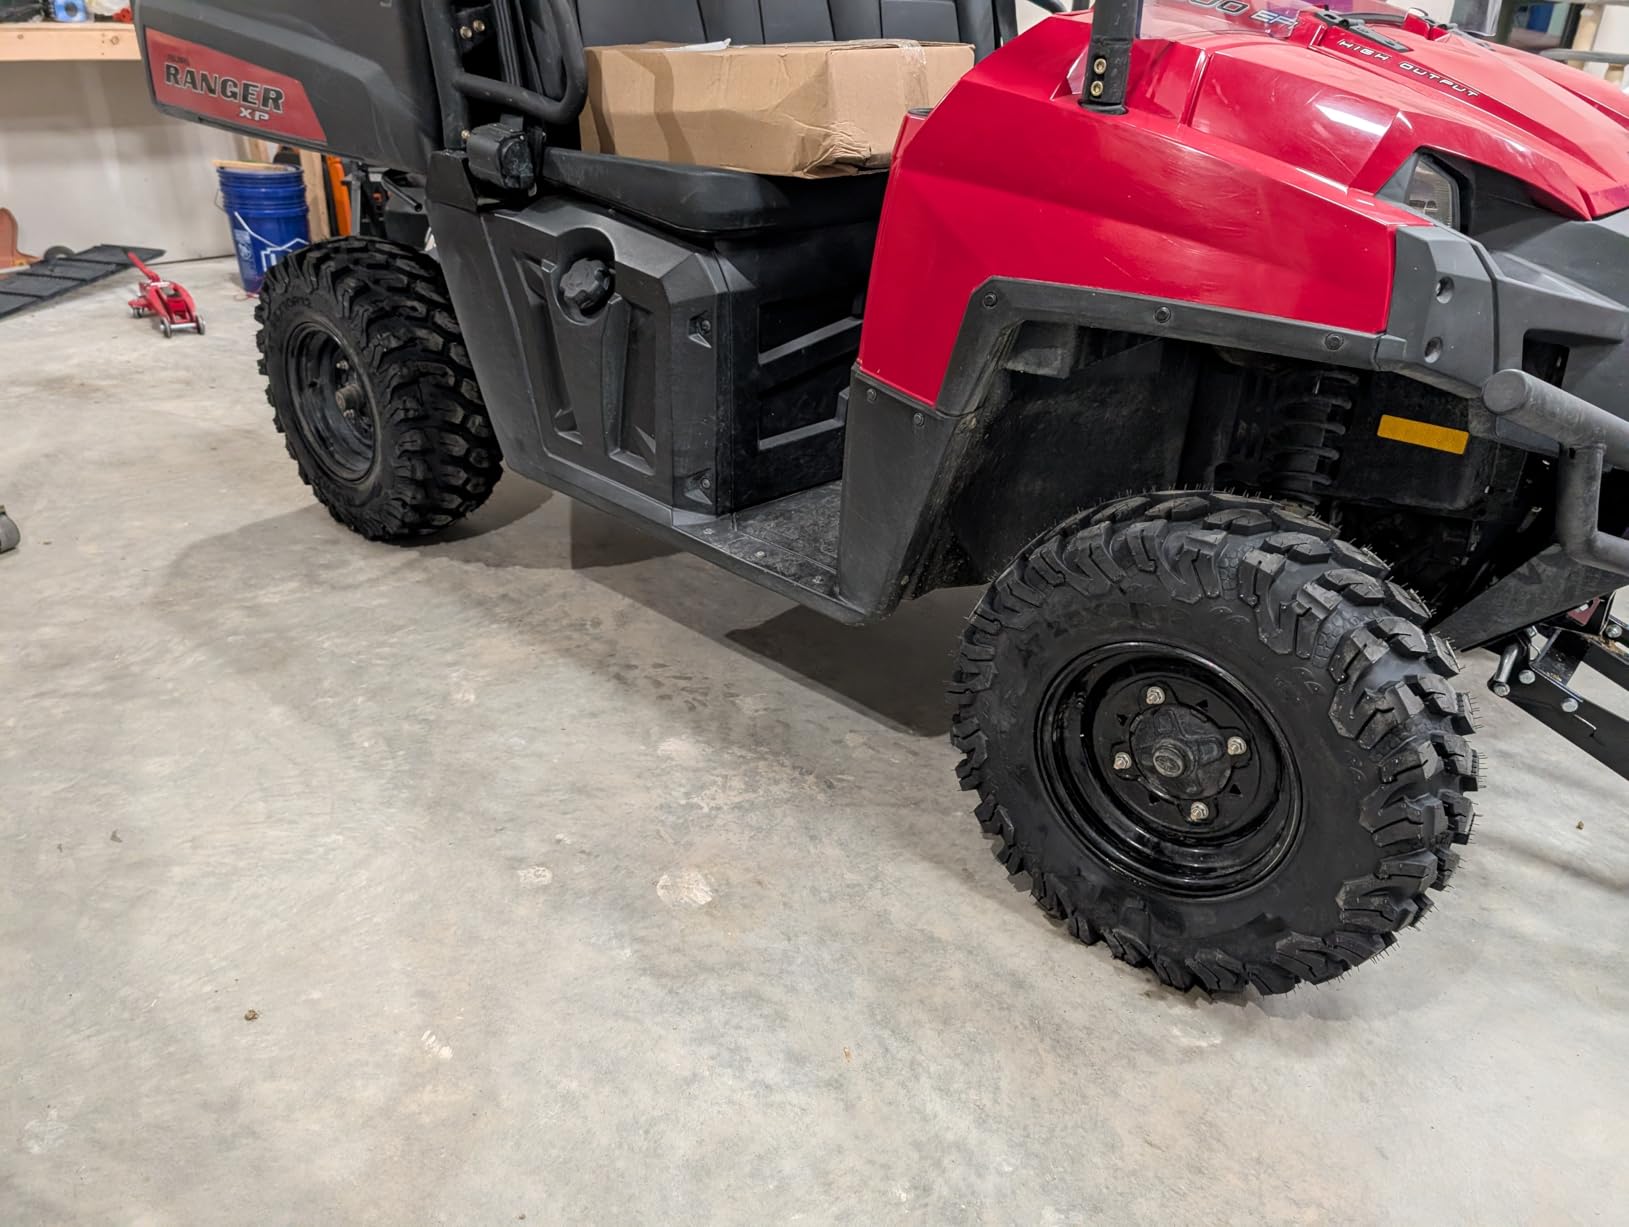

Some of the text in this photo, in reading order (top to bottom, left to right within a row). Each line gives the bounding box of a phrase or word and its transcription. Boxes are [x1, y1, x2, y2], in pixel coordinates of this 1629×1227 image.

[164, 62, 285, 113] RANGER
[1337, 39, 1480, 97] HIGH OUTPUT
[239, 106, 270, 121] XP
